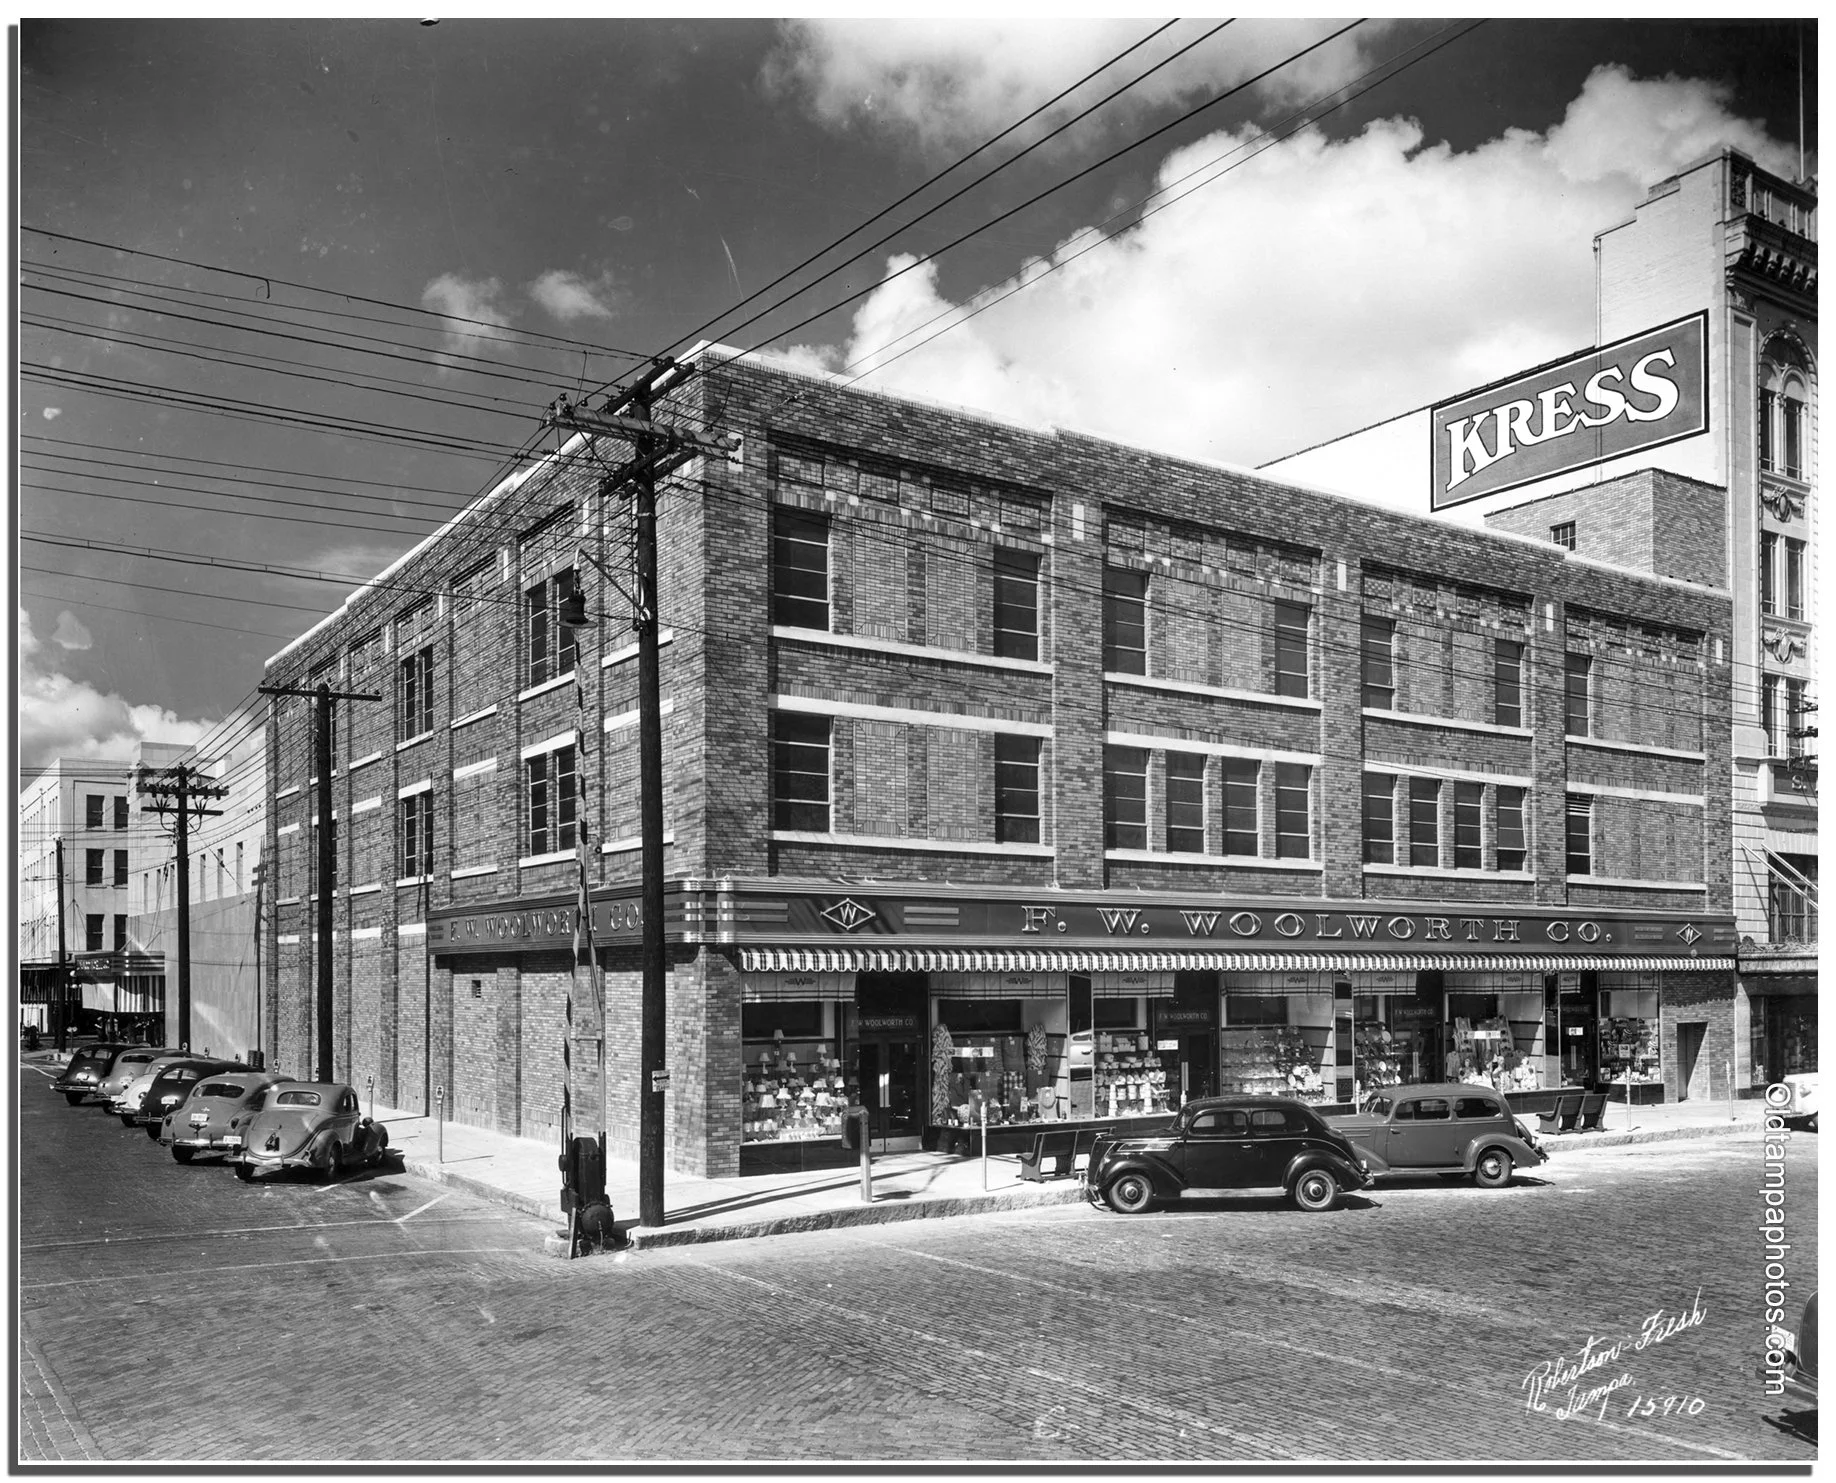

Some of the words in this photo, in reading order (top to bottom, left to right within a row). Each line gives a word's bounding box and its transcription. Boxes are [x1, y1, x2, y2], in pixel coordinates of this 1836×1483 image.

[1445, 346, 1680, 493] KRESS
[1791, 774, 1807, 790] S.
[839, 903, 858, 924] W
[1021, 905, 1067, 933] F.
[1096, 907, 1150, 934] W.
[1179, 910, 1521, 942] WOOLWORTH
[1546, 920, 1612, 943] CO.
[450, 920, 461, 943] F.
[465, 917, 480, 939] W.
[865, 1018, 903, 1027] WOOLWORTH
